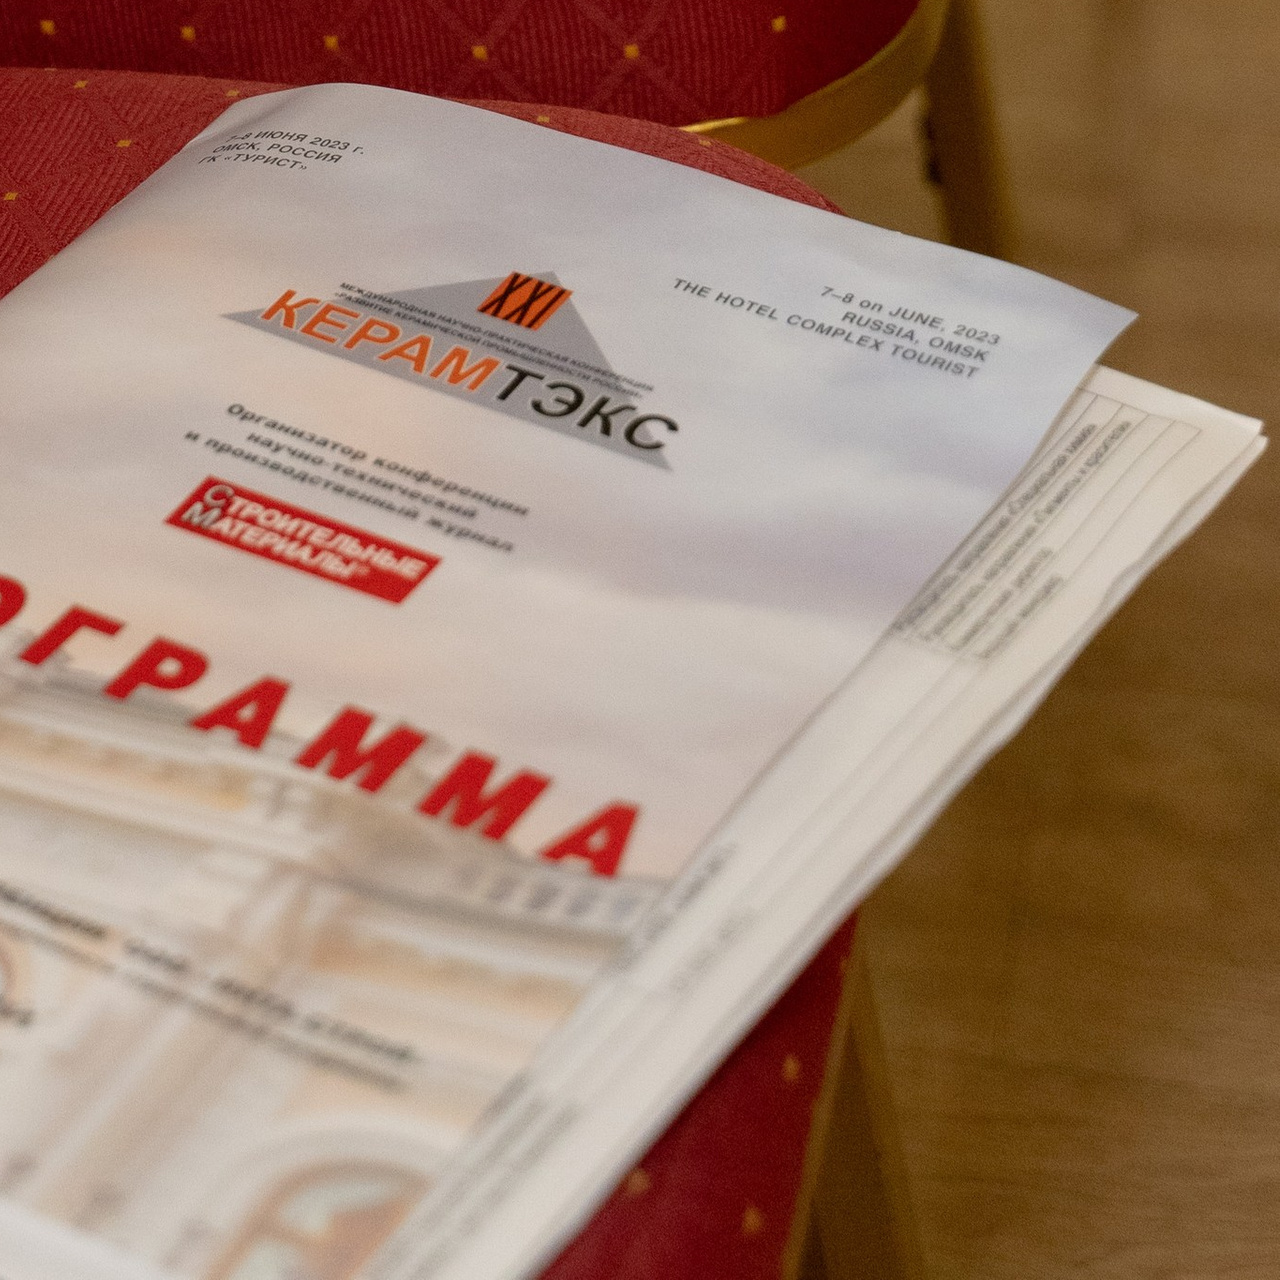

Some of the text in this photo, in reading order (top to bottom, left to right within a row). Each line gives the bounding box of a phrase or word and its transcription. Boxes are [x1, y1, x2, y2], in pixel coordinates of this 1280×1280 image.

[212, 142, 343, 164] ОМСК, РОССИЯ
[224, 152, 308, 171] «ТУРИСТ»
[254, 130, 309, 142] ИЮНЯ
[309, 136, 351, 151] 2023
[339, 282, 437, 319] МЕЖДУНАРОДНАЯ
[858, 298, 884, 314] on
[887, 302, 947, 334] JUNE,
[953, 322, 1001, 346] 2023
[673, 277, 980, 380] THE HOTEL COMPLEX TOURIST
[841, 309, 990, 363] RUSSIA, OMSK
[261, 288, 680, 451] КЕРАМТЭКС
[227, 402, 531, 517] Организатор конференции
[184, 431, 515, 553] и производственный журнал
[202, 483, 429, 580] СТРОИТЕЛЬНЫЕ
